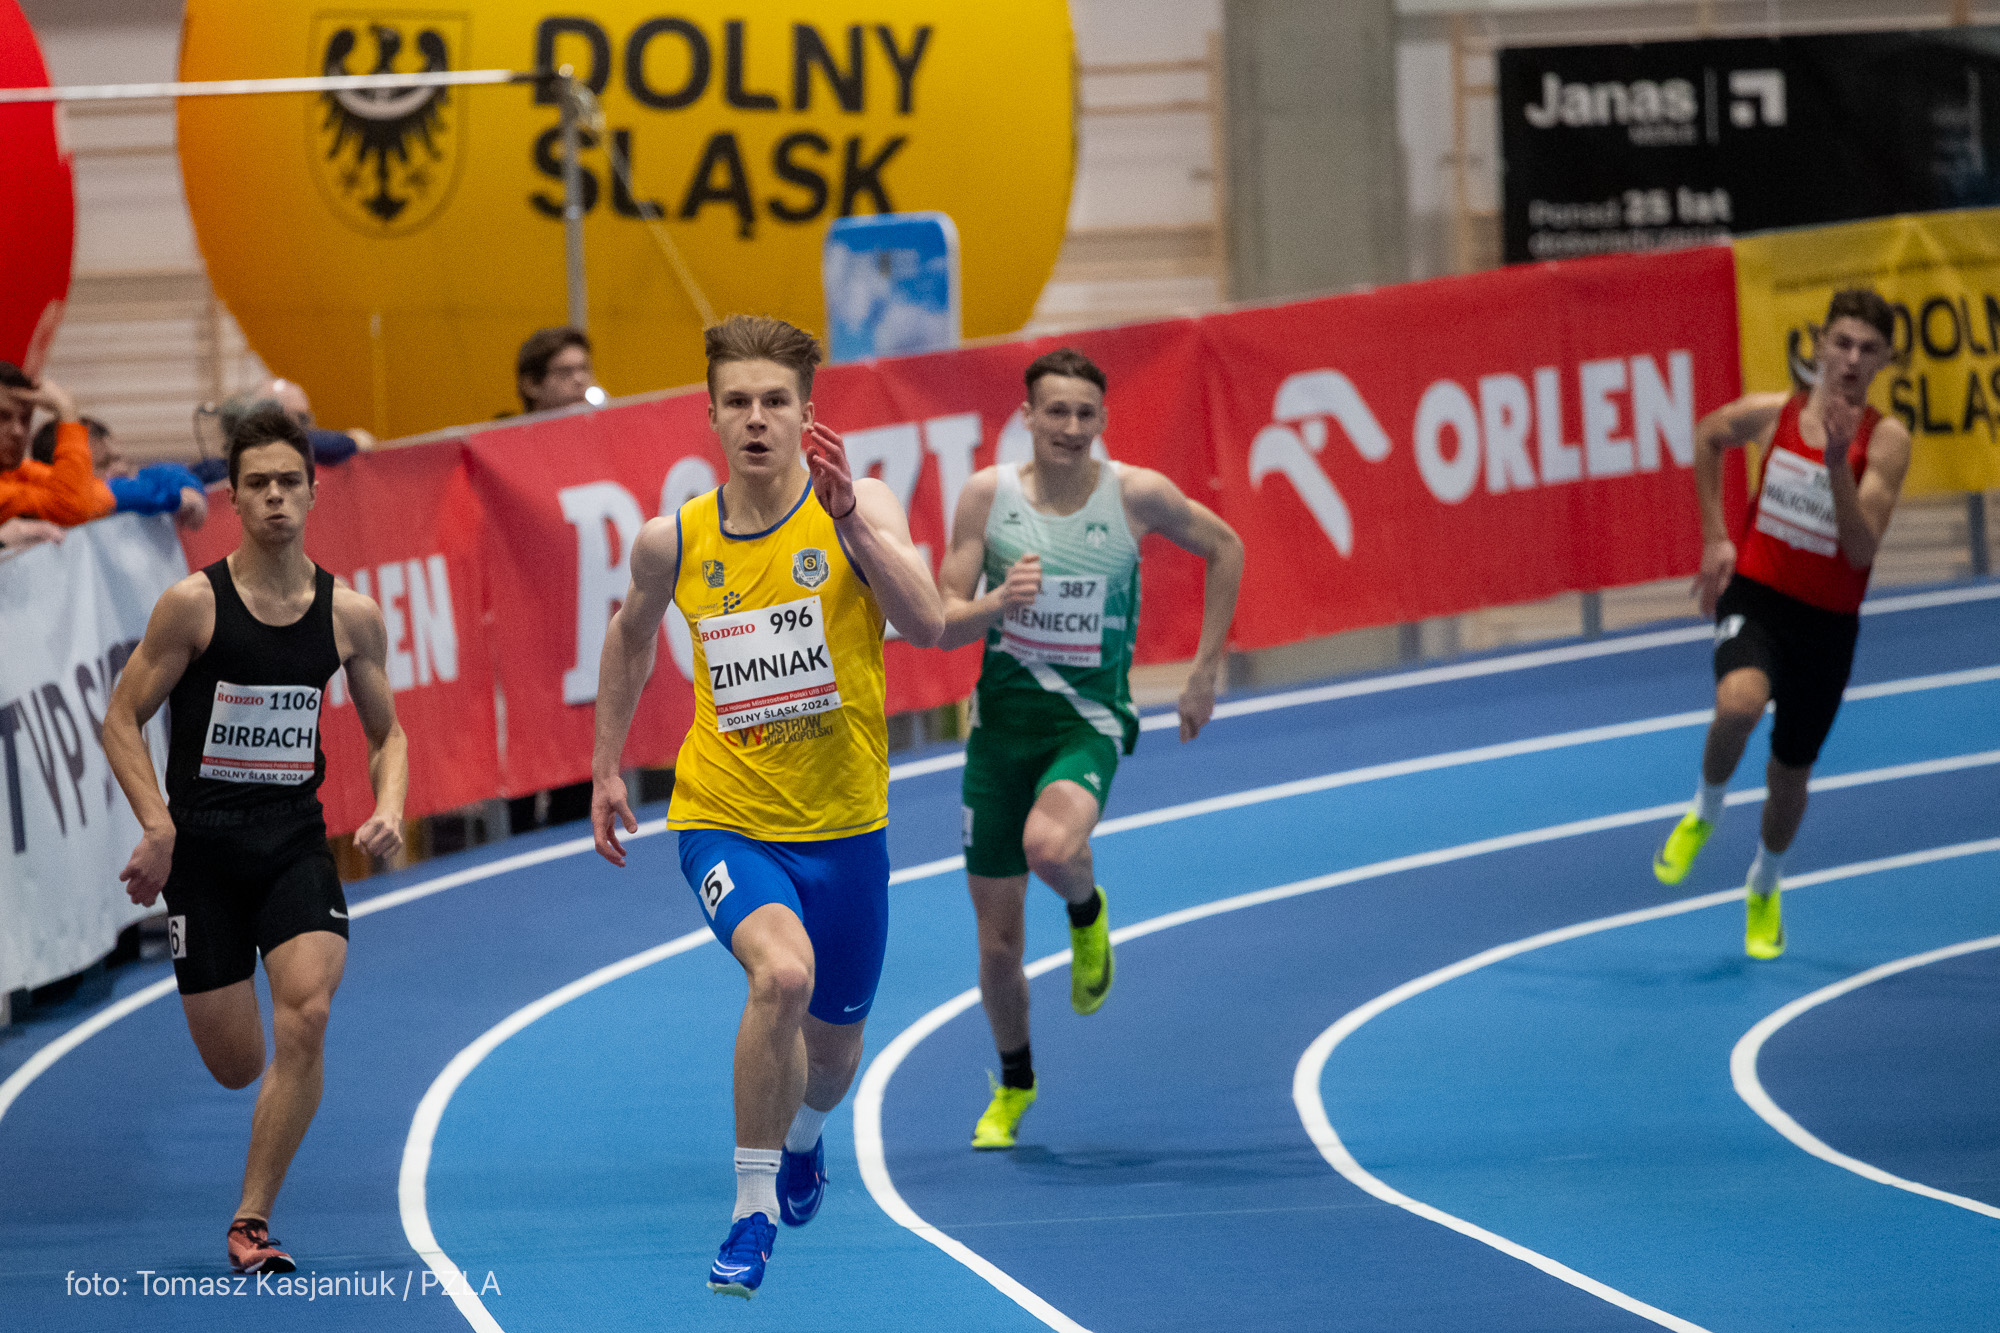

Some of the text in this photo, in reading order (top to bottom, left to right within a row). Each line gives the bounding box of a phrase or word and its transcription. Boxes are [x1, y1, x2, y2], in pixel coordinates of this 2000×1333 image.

[533, 17, 935, 115] DOLNY
[1524, 71, 1697, 129] Janas
[1412, 350, 1695, 504] ORLEN
[1060, 581, 1097, 598] 387
[701, 605, 813, 642] BODZIO 996
[710, 644, 829, 690] ZIMNIAK
[217, 692, 317, 710] BODZIO 1106
[727, 698, 830, 727] DOLNY ŚLĄSK 2024
[790, 691, 808, 700] Polski
[211, 723, 313, 749] BIRBACH
[764, 725, 833, 746] WIELKOPOLSKI
[0, 682, 87, 855] TVP
[212, 769, 304, 782] DOLNY ŚLĄSK 2024
[704, 870, 723, 907] 5
[170, 920, 180, 956] 6
